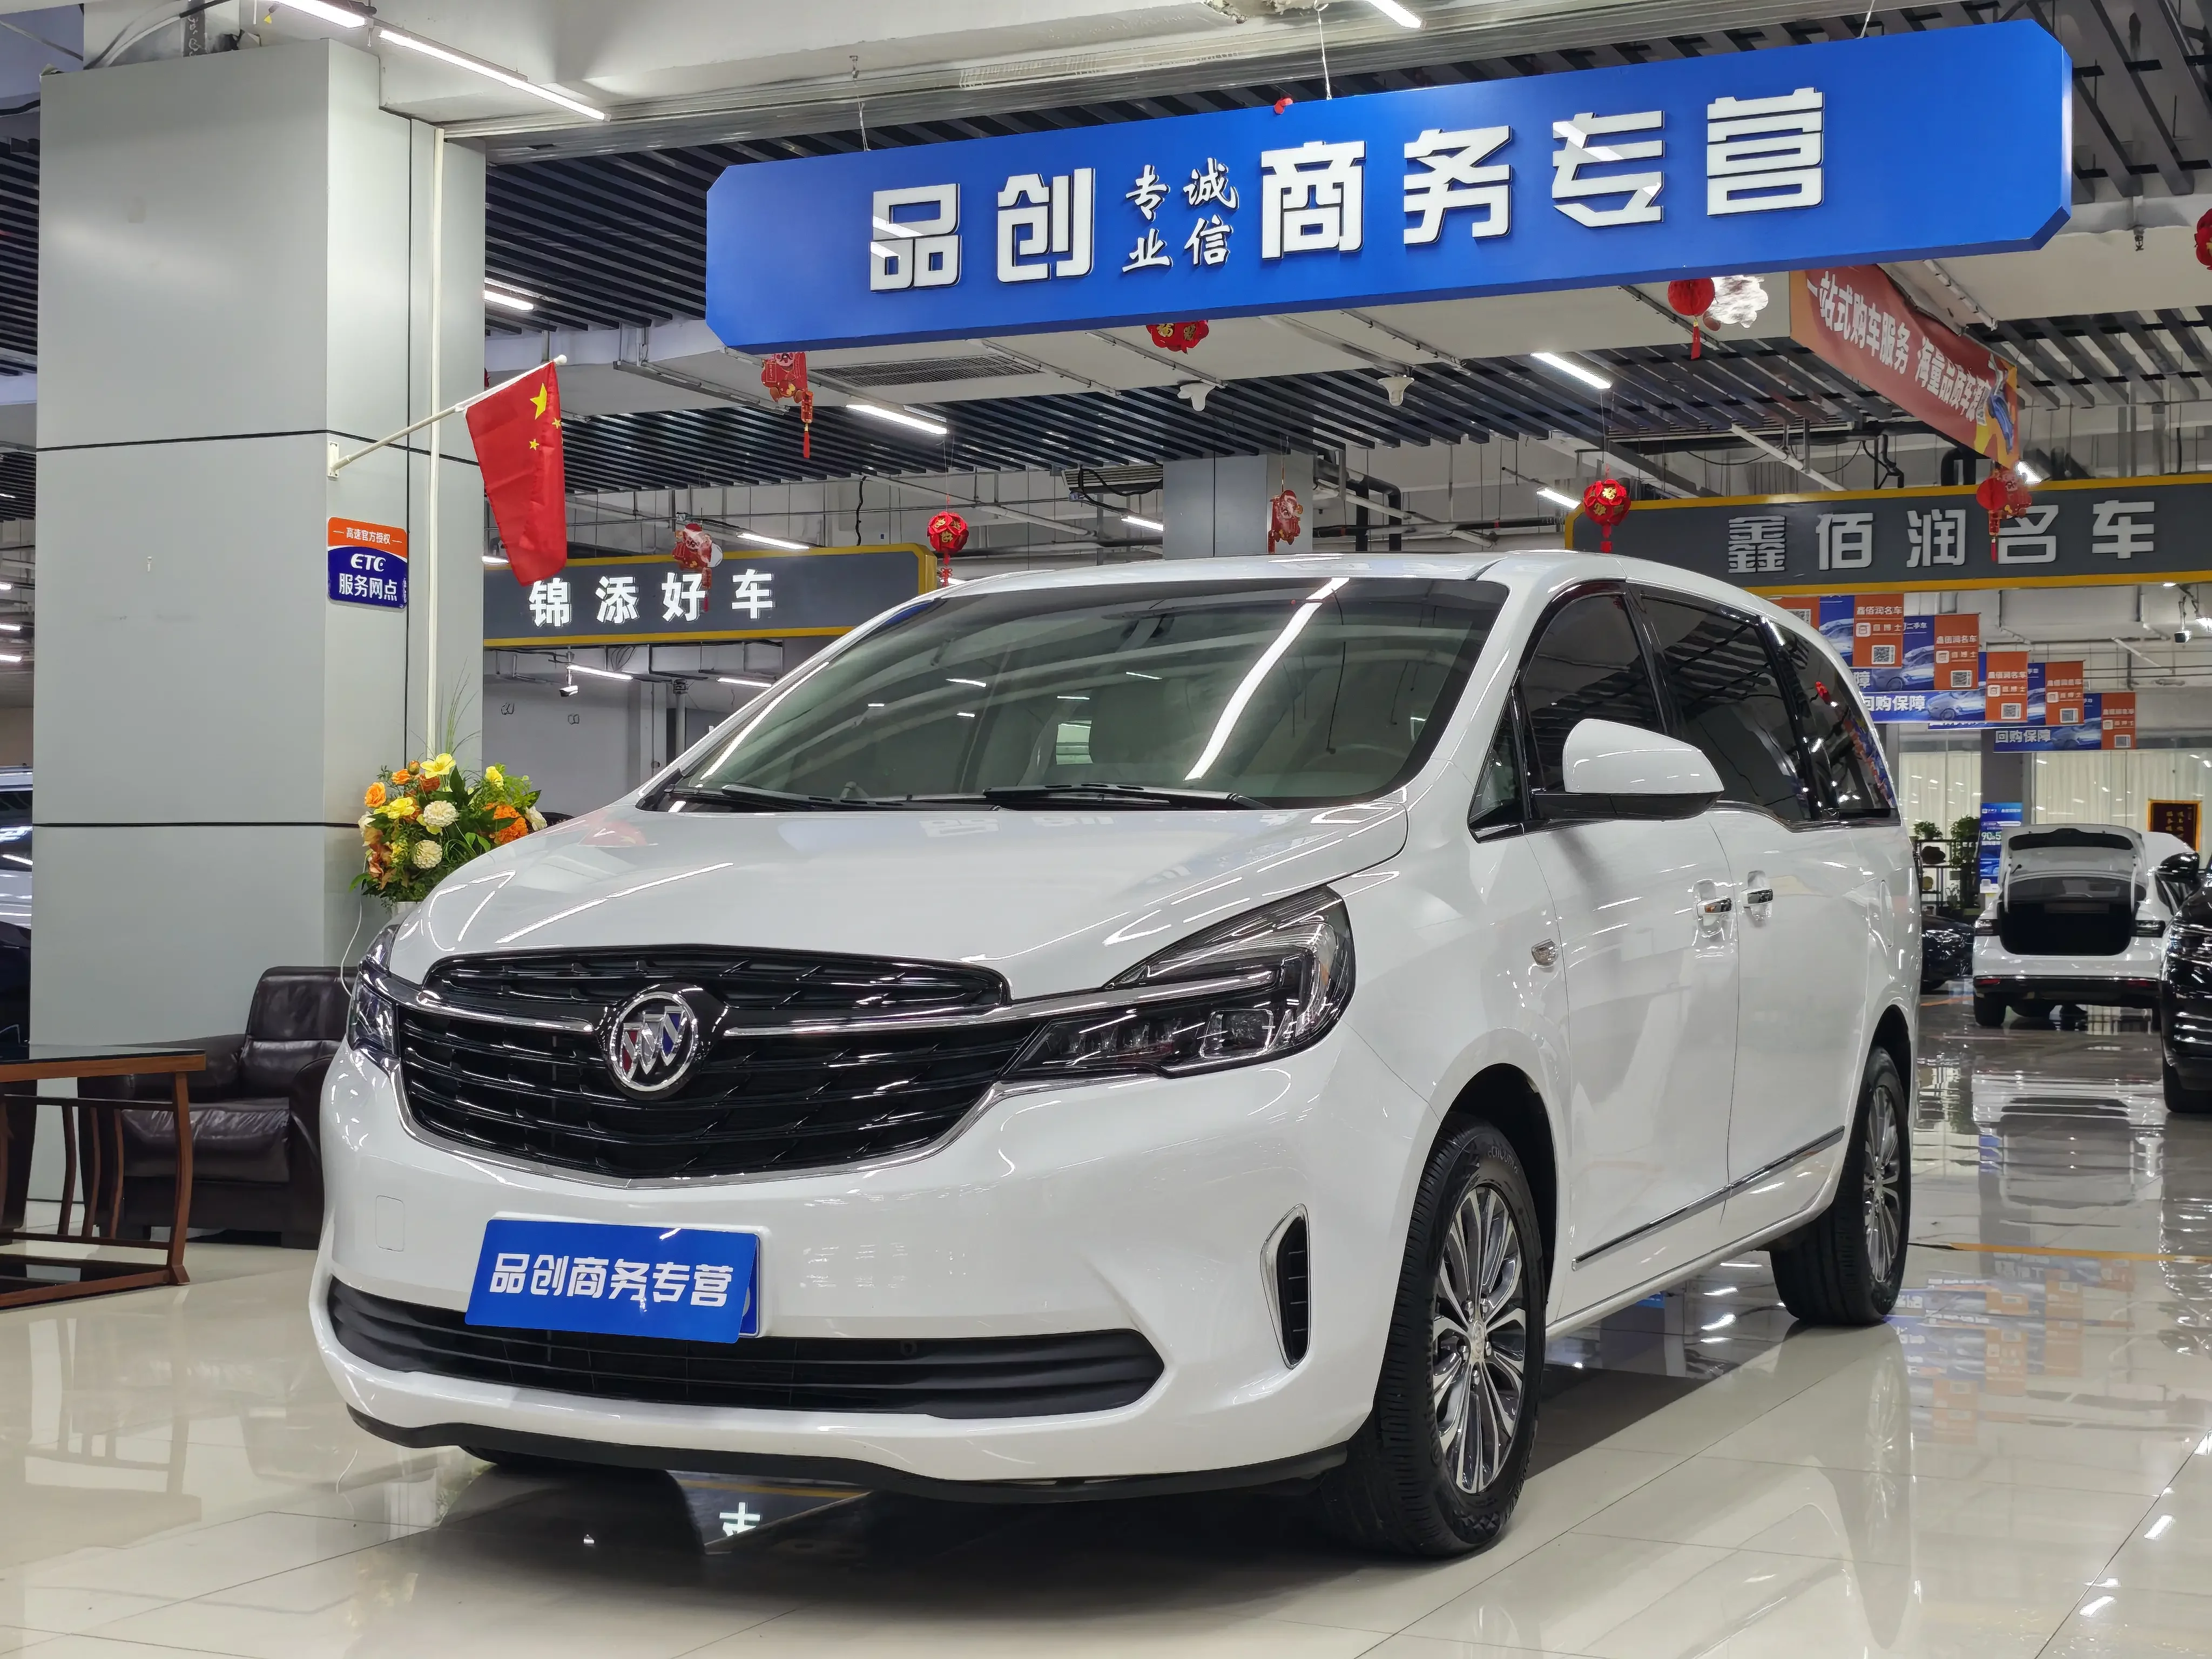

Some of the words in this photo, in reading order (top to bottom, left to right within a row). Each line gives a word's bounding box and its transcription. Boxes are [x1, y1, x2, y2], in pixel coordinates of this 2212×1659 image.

[1261, 86, 1824, 259] 商务专营
[870, 168, 1095, 293] 品创
[1807, 271, 1911, 375] 一站式购车服务
[346, 527, 391, 545] 高速官方授权
[350, 553, 387, 572] ETC
[1729, 500, 2155, 574] 鑫佰润名车
[339, 572, 397, 602] 服务网点
[529, 569, 774, 628] 锦添好车
[489, 1253, 733, 1307] 品创商务专营
